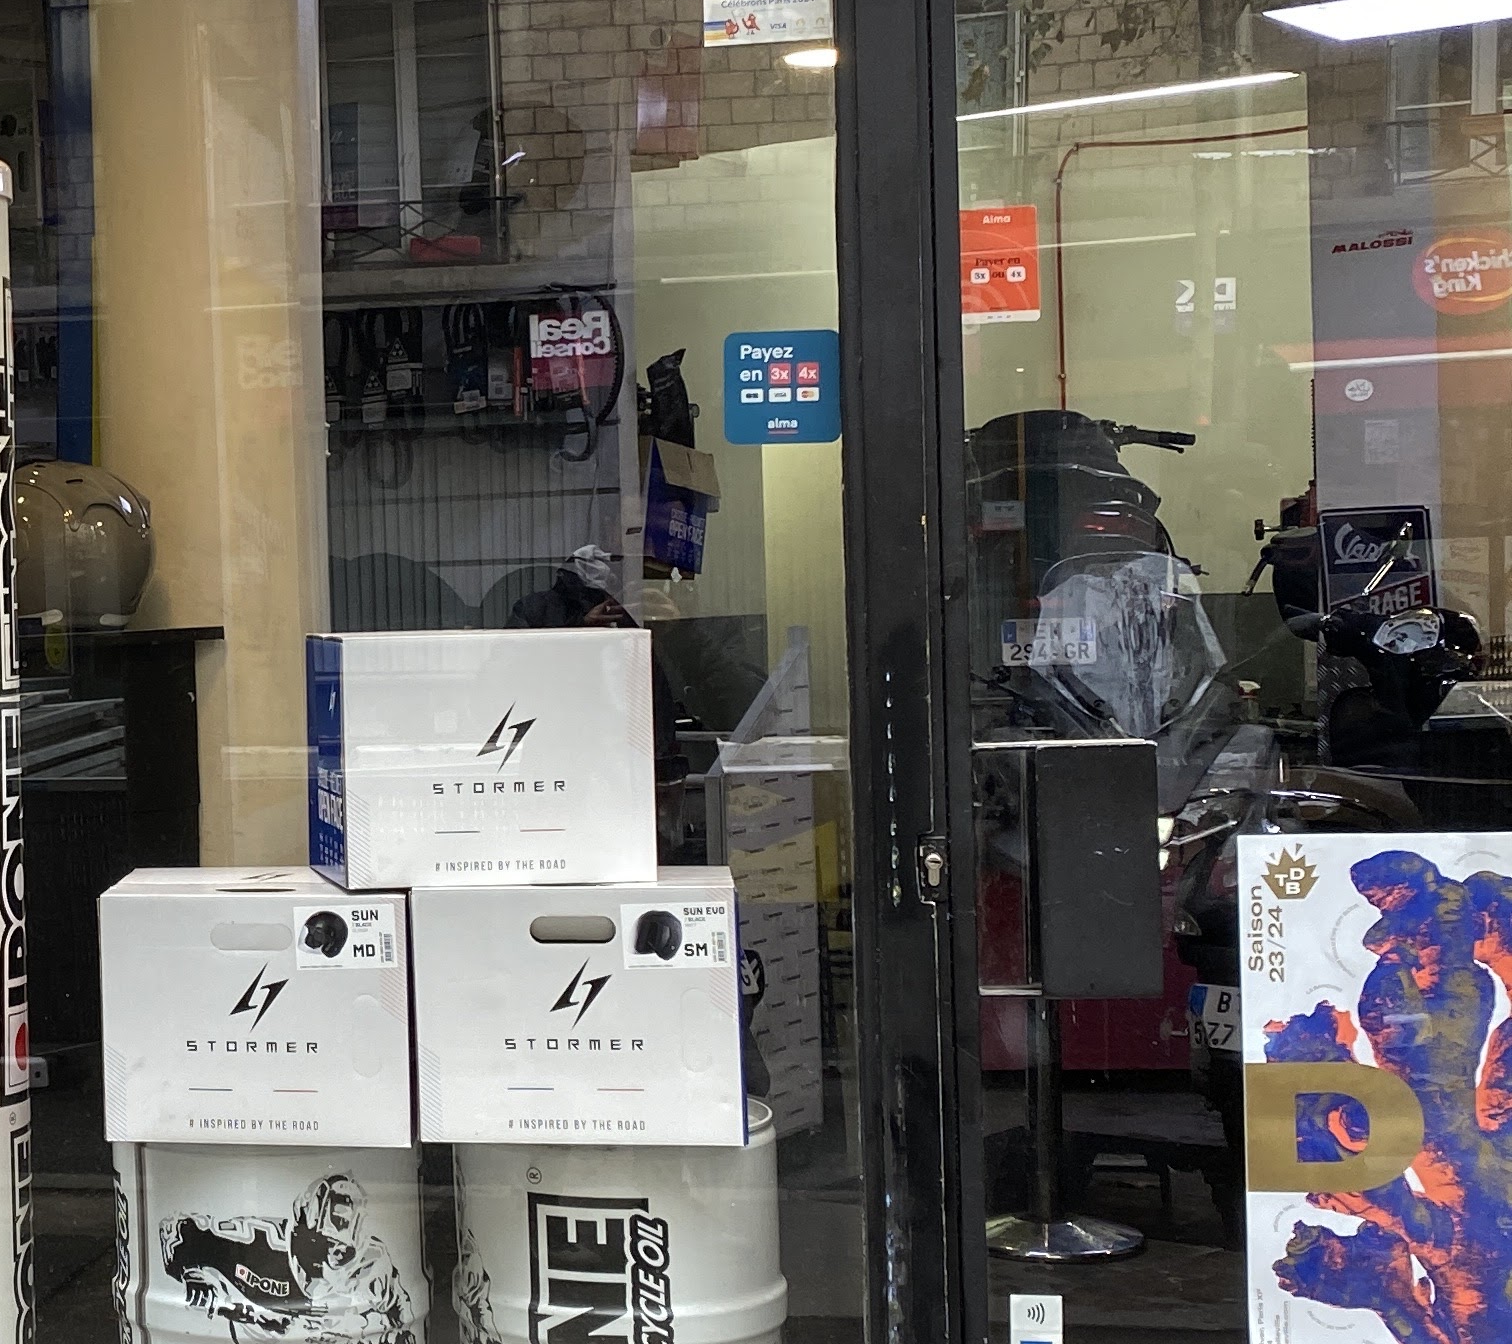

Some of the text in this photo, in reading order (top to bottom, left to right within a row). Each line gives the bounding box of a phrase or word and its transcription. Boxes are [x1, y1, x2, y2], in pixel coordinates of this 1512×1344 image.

[1331, 236, 1413, 254] MALOSSI
[740, 344, 794, 363] Payez
[739, 366, 817, 382] en 3x 4x
[767, 417, 798, 429] alma
[433, 781, 565, 794] STORMER
[446, 859, 566, 872] INSPIRED BY THE ROAD
[351, 909, 379, 921] SUN
[683, 906, 726, 916] SUN EVO
[1247, 885, 1264, 972] Saison
[353, 944, 376, 957] MD
[684, 943, 708, 957] SM
[1266, 905, 1286, 983] 23/24
[186, 1040, 318, 1053] STORMER
[504, 1038, 643, 1051] STORMER
[199, 1119, 319, 1131] INSPIRED BY THE ROAD
[519, 1119, 646, 1131] INSPIRED BY THE ROAD
[637, 1219, 666, 1264] OIL
[246, 1271, 289, 1296] IPONE
